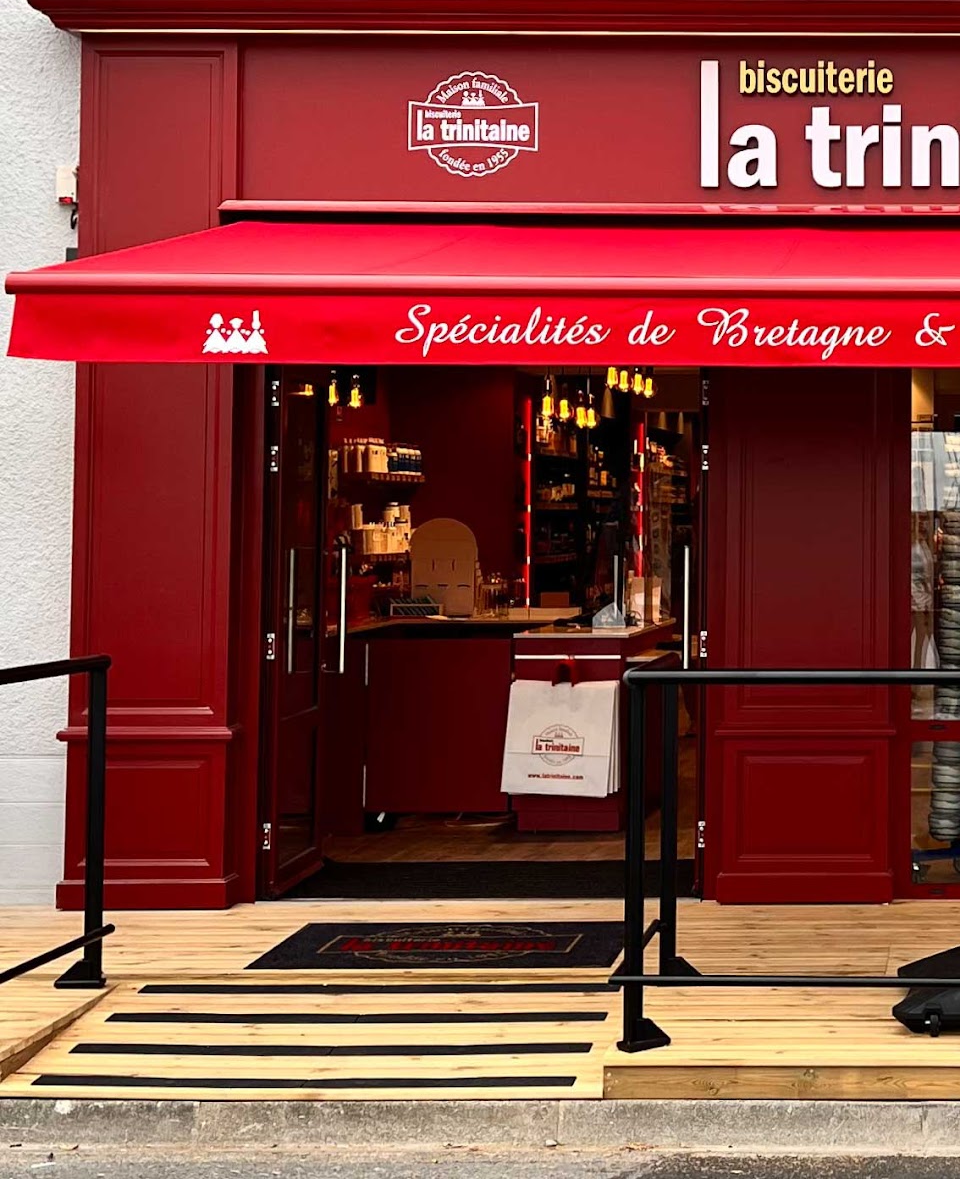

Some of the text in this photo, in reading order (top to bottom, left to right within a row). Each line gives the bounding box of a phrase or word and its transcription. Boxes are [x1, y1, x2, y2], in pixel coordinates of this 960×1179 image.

[436, 77, 509, 104] Maison familiale
[739, 60, 894, 94] biscuiterie
[416, 109, 531, 142] la trinitaine
[700, 60, 778, 189] la
[438, 147, 509, 172] fondée en 1955
[394, 304, 611, 357] Spécialités
[627, 310, 677, 345] de
[697, 307, 893, 360] Bretagne
[914, 312, 956, 347] &
